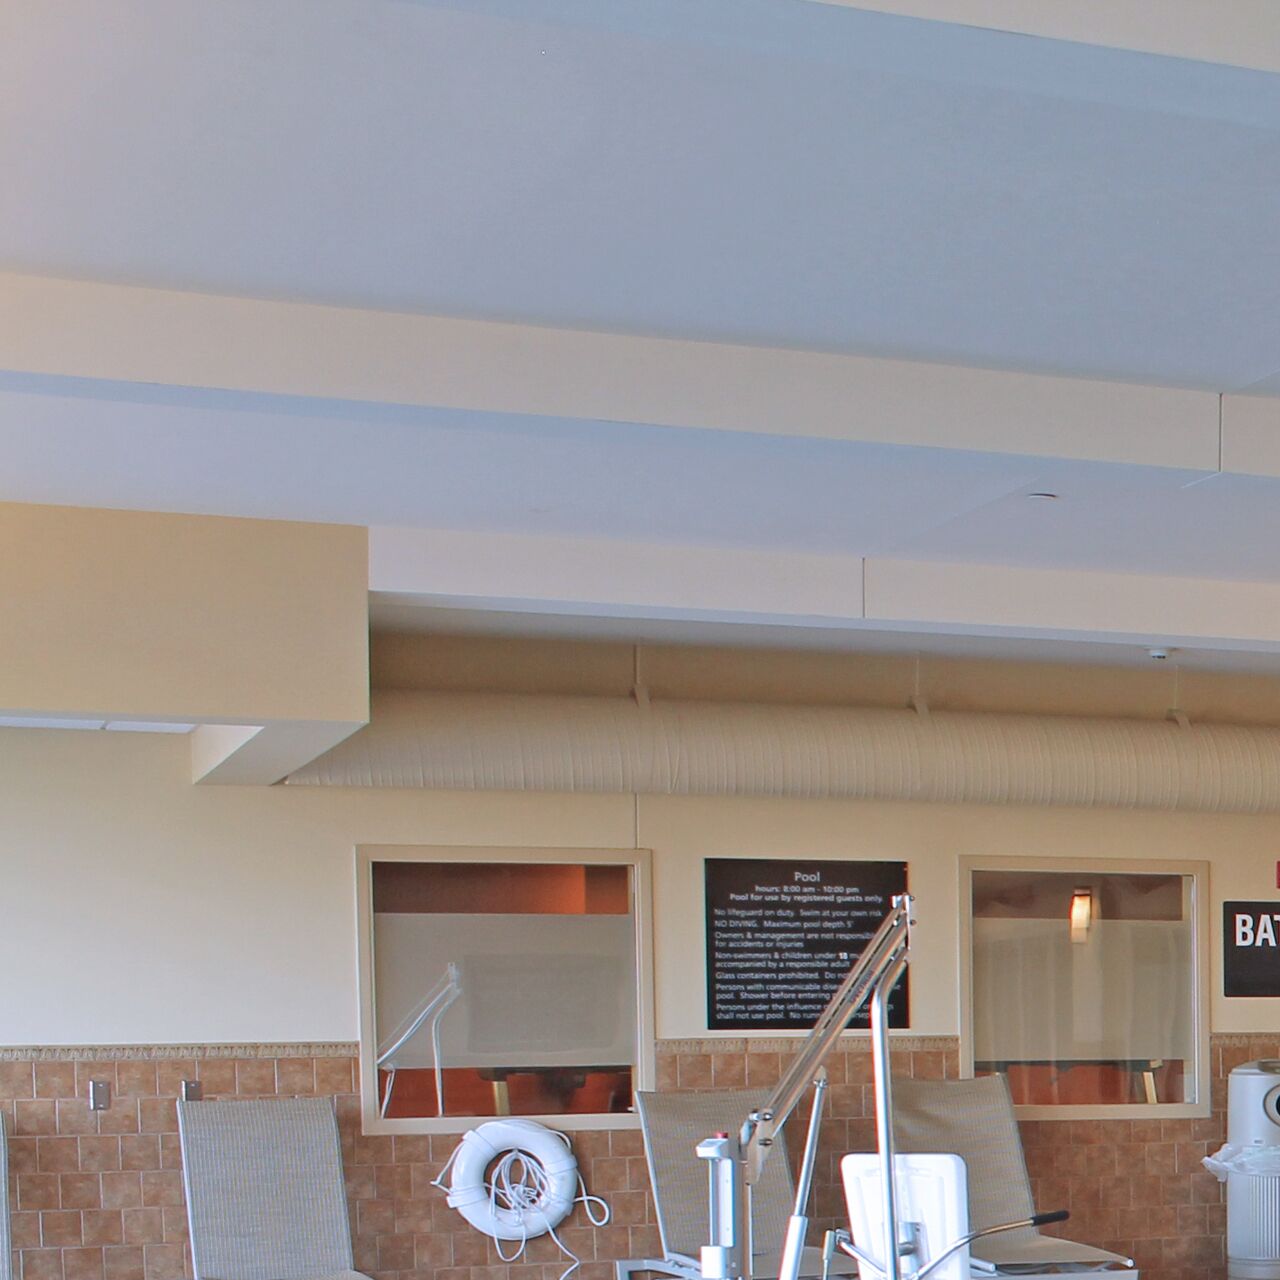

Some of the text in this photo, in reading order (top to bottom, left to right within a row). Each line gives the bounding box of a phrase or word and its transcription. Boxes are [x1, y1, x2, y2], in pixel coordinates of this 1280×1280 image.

[794, 872, 820, 882] Pool
[730, 893, 748, 901] Pool
[750, 893, 763, 901] for
[781, 894, 791, 902] by
[794, 894, 834, 903] registered
[836, 895, 862, 903] guests
[728, 909, 762, 918] lifeguard
[832, 910, 849, 918] your
[715, 920, 728, 928] NO
[764, 920, 801, 928] Maximum
[803, 921, 821, 929] pool
[823, 921, 845, 929] depth
[755, 933, 804, 941] management
[715, 940, 726, 948] for
[728, 940, 765, 948] accidents
[715, 961, 766, 969] accompanied
[767, 961, 777, 969] by
[786, 961, 828, 969] responsible
[798, 992, 830, 1000] entering
